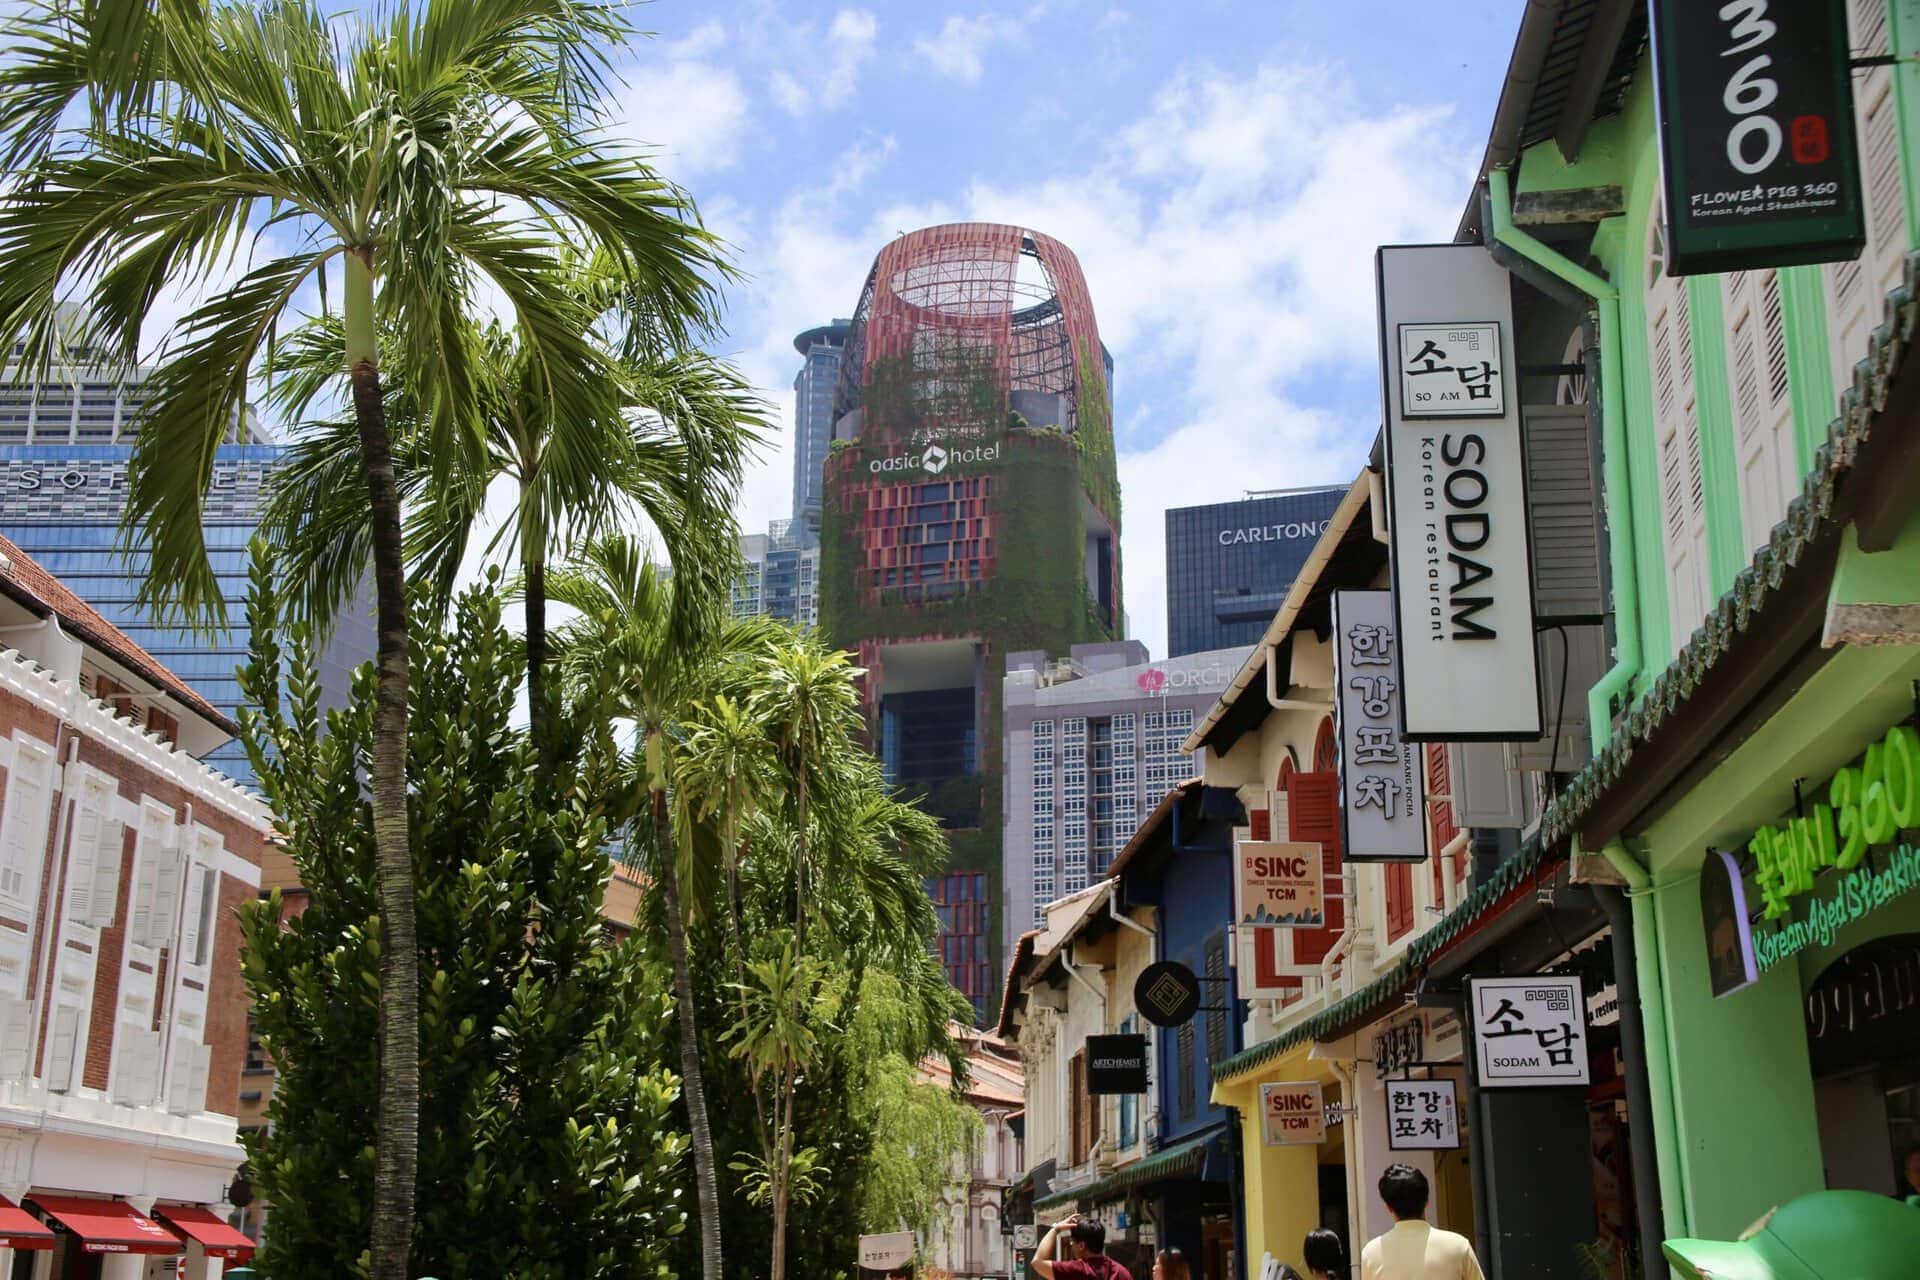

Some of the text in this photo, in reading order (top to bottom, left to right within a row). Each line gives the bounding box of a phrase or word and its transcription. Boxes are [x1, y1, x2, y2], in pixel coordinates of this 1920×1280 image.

[1719, 0, 1783, 174] 360
[1690, 182, 1838, 206] FLOWER PIG 360
[1692, 199, 1837, 217] Korean Aged Steakhouse
[1405, 340, 1499, 400] 소담
[869, 441, 1000, 473] oasia hotel
[1218, 520, 1316, 546] CARLTON
[1421, 437, 1444, 642] Korean restaurant
[1440, 433, 1497, 641] SODAM
[1349, 623, 1401, 820] 한강포차
[1403, 742, 1415, 817] ANKANG POCHA
[1830, 727, 1920, 870] 360
[1254, 857, 1307, 878] SINC
[1266, 888, 1296, 900] TCM
[1752, 920, 1808, 972] Korean
[1808, 879, 1848, 947] Aged
[1482, 998, 1580, 1067] 소담
[1493, 1057, 1541, 1068] SODAM
[1272, 1093, 1313, 1111] SINC
[1281, 1117, 1309, 1130] TCM
